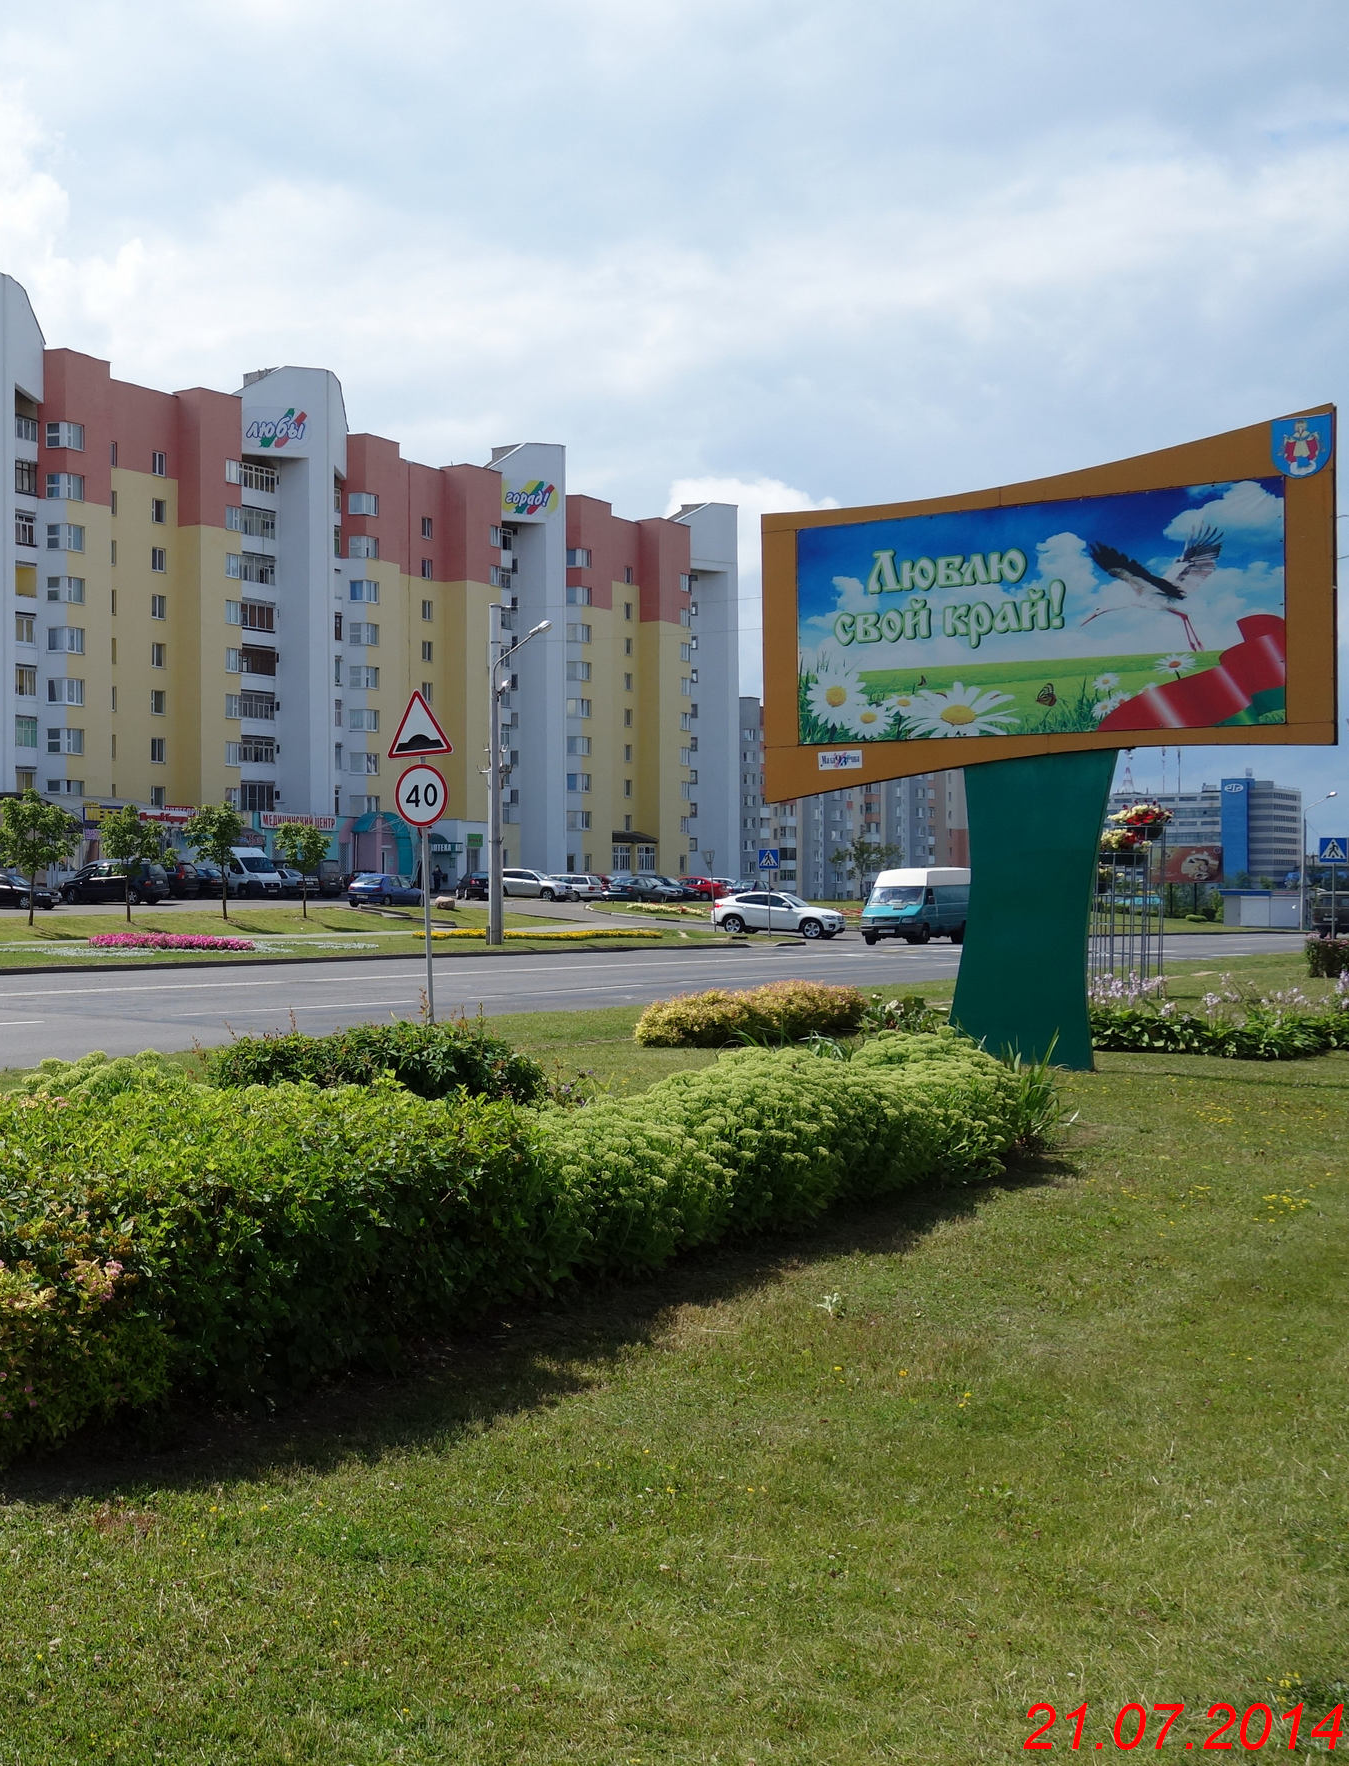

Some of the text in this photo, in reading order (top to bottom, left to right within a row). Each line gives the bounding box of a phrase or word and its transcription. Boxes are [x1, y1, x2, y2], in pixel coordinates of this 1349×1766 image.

[868, 548, 1027, 594] Люблю
[835, 579, 1065, 648] свой край!
[406, 783, 437, 807] 40
